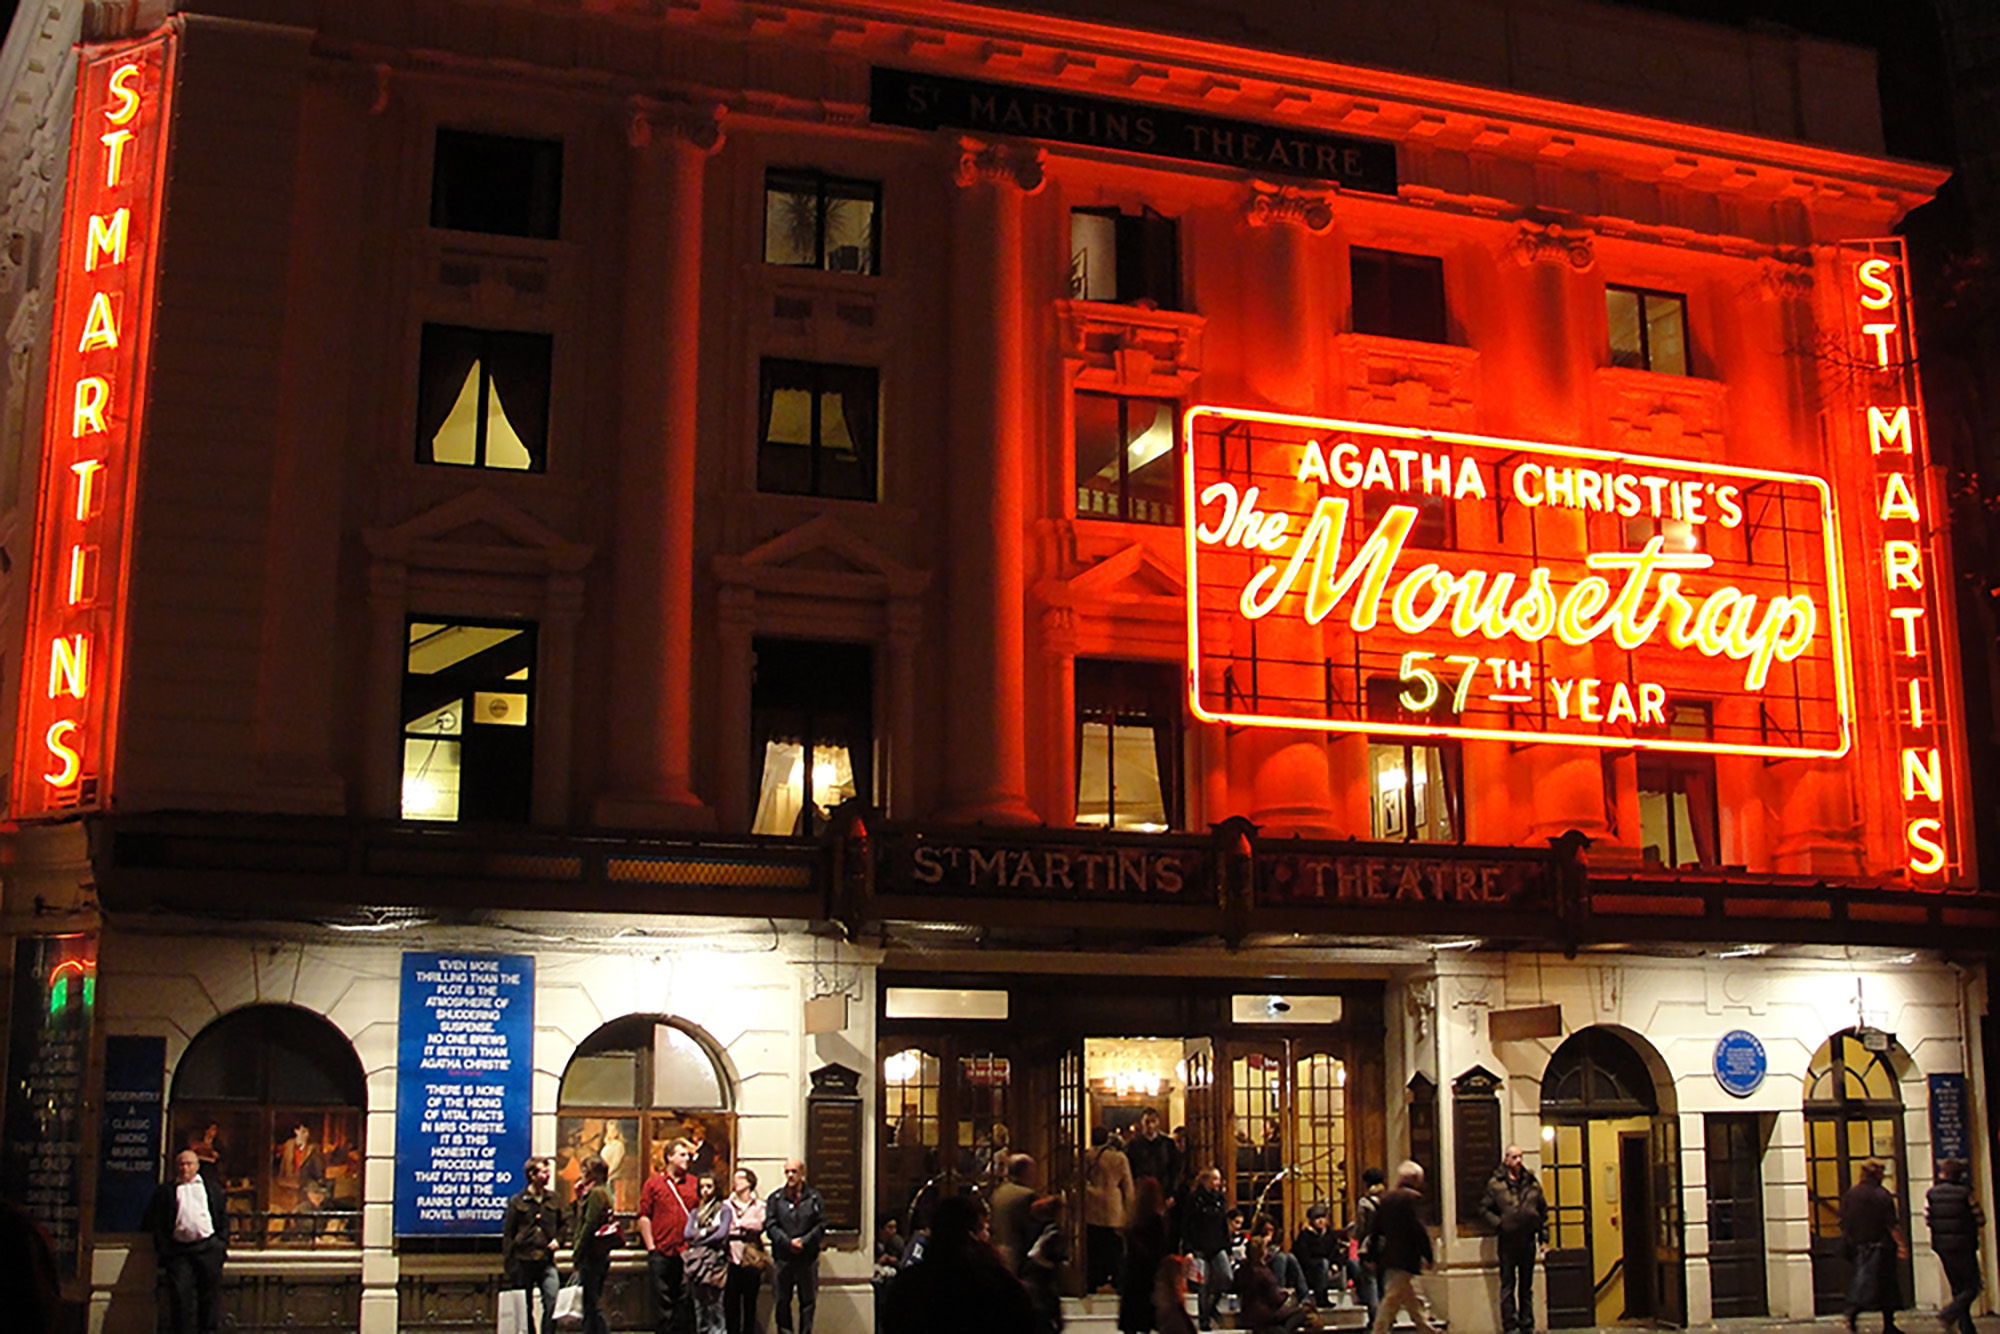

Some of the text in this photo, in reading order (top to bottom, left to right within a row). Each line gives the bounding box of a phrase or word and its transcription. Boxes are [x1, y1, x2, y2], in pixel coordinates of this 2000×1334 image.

[970, 97, 1156, 146] MARTINS
[1186, 124, 1364, 177] THEATRE
[1298, 439, 1743, 529] AGATHA CHRISTIE'S
[1197, 482, 1818, 691] The Mousetrap
[1549, 677, 1667, 724] YEAR
[1306, 861, 1507, 902] THEATRE
[416, 971, 520, 985] THRILLING THAN THE
[437, 985, 498, 996] PLOT IS THE
[425, 996, 509, 1008] ATMOSPHERE OF
[427, 1034, 507, 1046] NO ONE BREWS
[424, 1046, 508, 1058] IT BETTER THAN
[420, 1058, 462, 1069] AGATHA
[463, 1085, 474, 1096] IS
[476, 1086, 505, 1096] NONE
[427, 1097, 442, 1108] OF
[445, 1097, 464, 1108] THE
[424, 1109, 504, 1121] OF VITAL FACTS
[421, 1122, 432, 1132] IN
[440, 1134, 488, 1146] IT IS THIS
[431, 1147, 496, 1158] HONESTY OF
[432, 1159, 495, 1170] PROCEDURE
[415, 1171, 441, 1182] THAT
[443, 1172, 470, 1182] PUTS
[496, 1172, 512, 1183] SO
[432, 1184, 494, 1195] HIGH IN THE
[417, 1196, 508, 1208] RANKS OF POLICE
[420, 1209, 454, 1220] NOVEL
